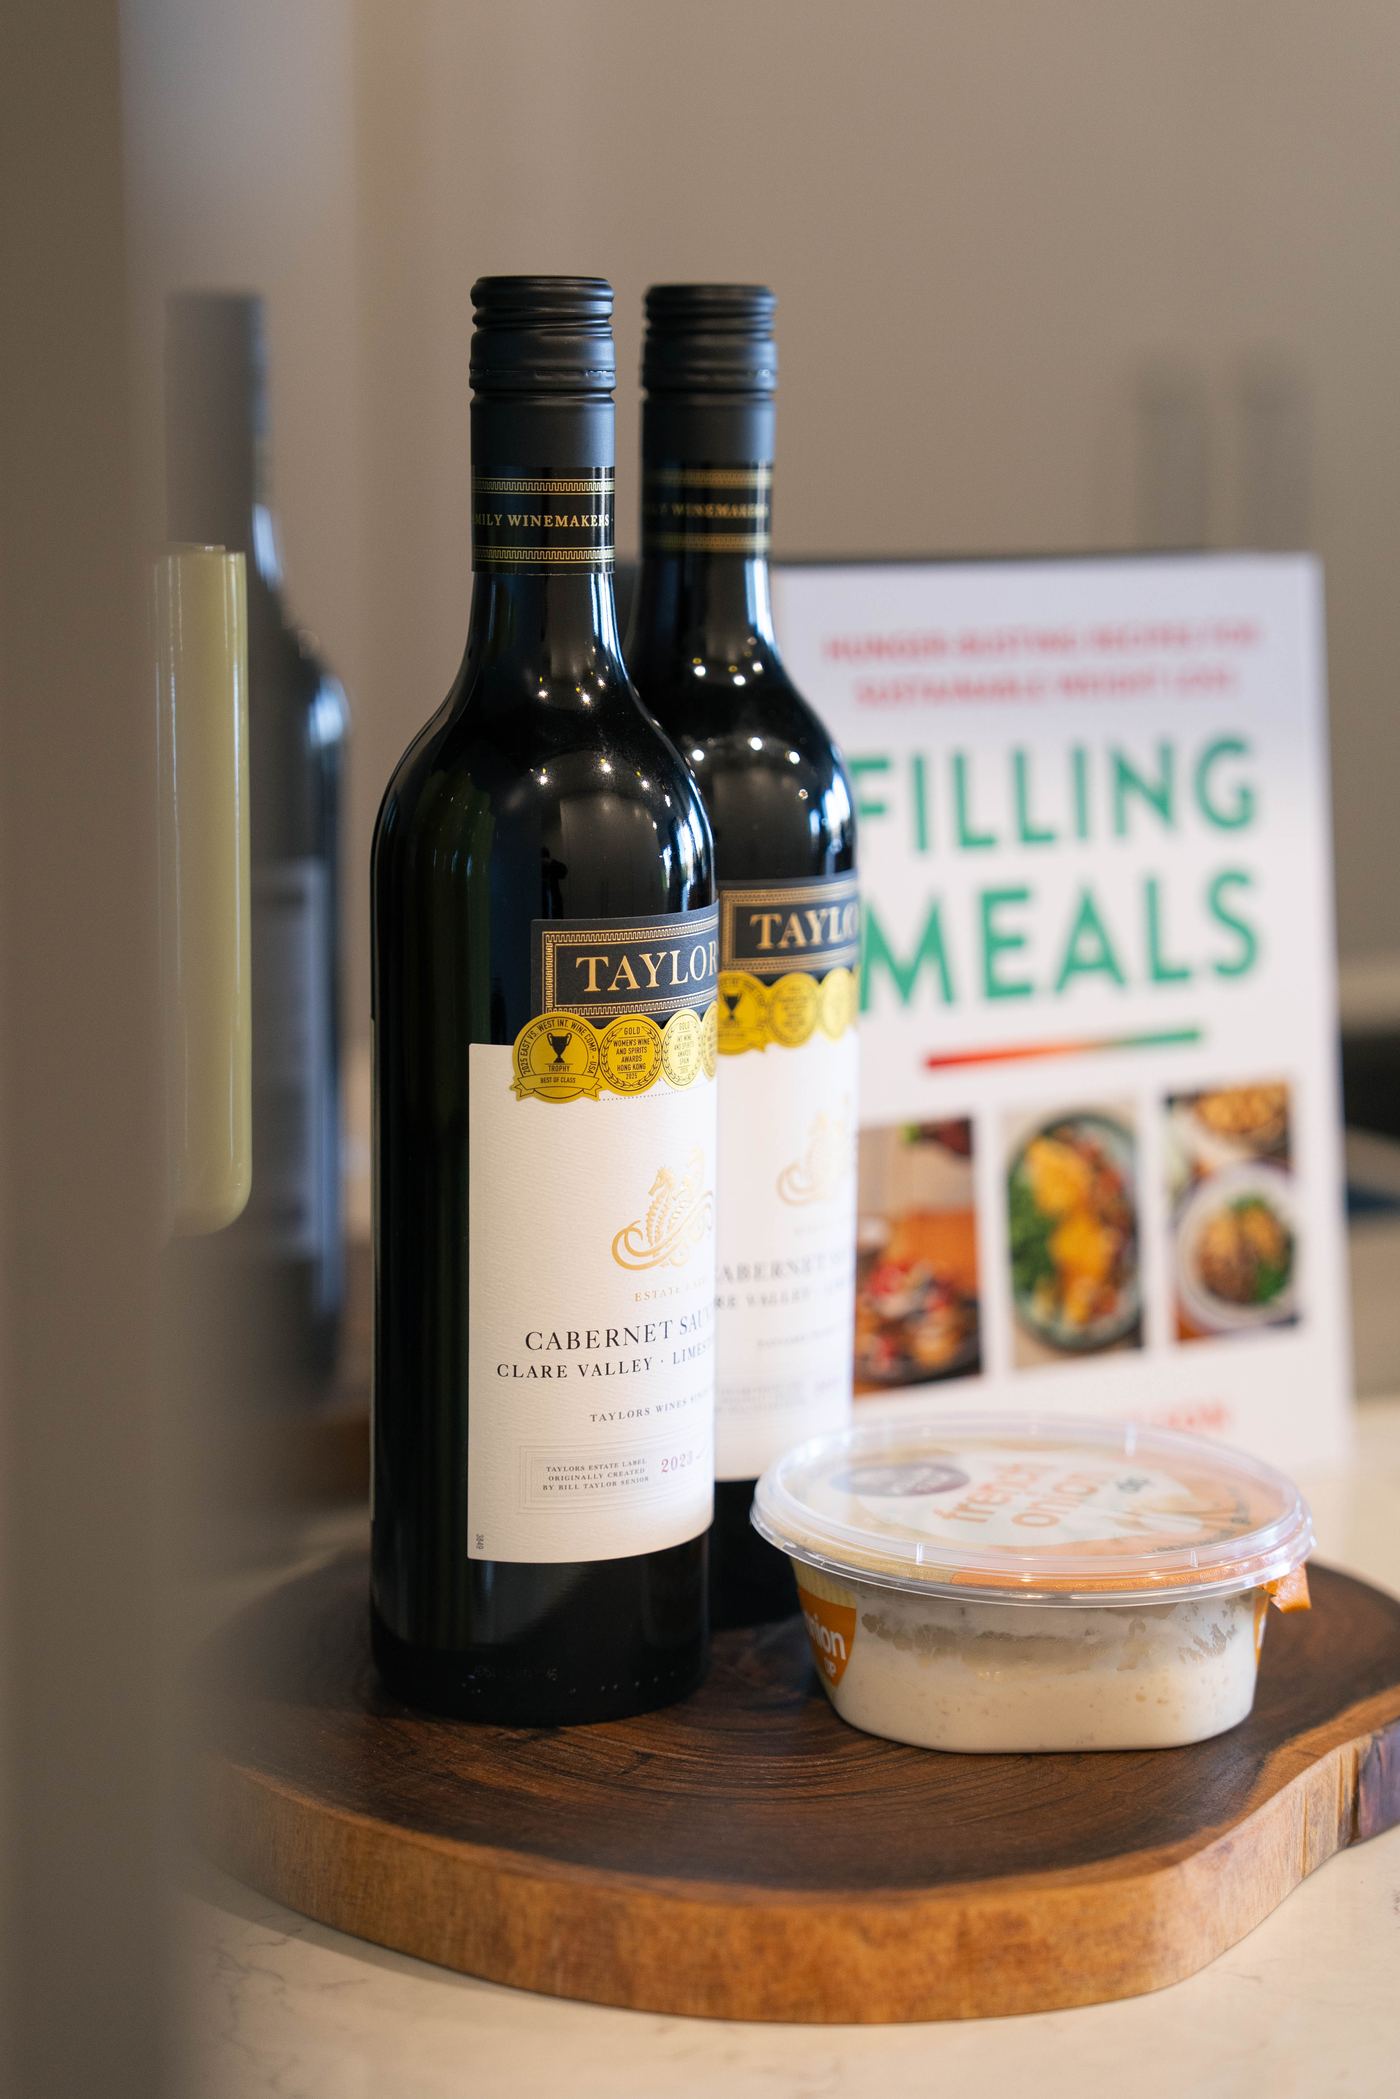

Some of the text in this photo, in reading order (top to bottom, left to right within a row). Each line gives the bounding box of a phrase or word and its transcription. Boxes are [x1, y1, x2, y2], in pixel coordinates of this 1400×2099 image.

[507, 514, 609, 527] WINEMAKERS
[849, 734, 1257, 852] FILLING
[859, 872, 1258, 1014] MEALS
[575, 940, 718, 992] TAYLOR
[624, 1027, 640, 1036] GOLD
[520, 1039, 531, 1056] EAST
[537, 1019, 555, 1032] WEST
[571, 1022, 586, 1035] WINE
[587, 1061, 597, 1074] USA
[613, 1038, 650, 1047] WOMEN'S WINE
[628, 1047, 648, 1055] SPIRITS
[621, 1055, 642, 1063] AWARDS
[616, 1063, 646, 1072] HONG KONG
[525, 1320, 673, 1350] CABERNET
[497, 1363, 568, 1378] CLARE
[577, 1357, 653, 1377] VALLEY
[590, 1399, 687, 1422] TAYLORS WINES
[546, 1465, 585, 1473] TAYLORS
[588, 1462, 619, 1471] ESTATE
[548, 1468, 646, 1482] ORIGINALLY CREATED
[583, 1481, 617, 1489] TAYLOR
[621, 1476, 649, 1486] SENIOR
[803, 1610, 846, 1660] nion
